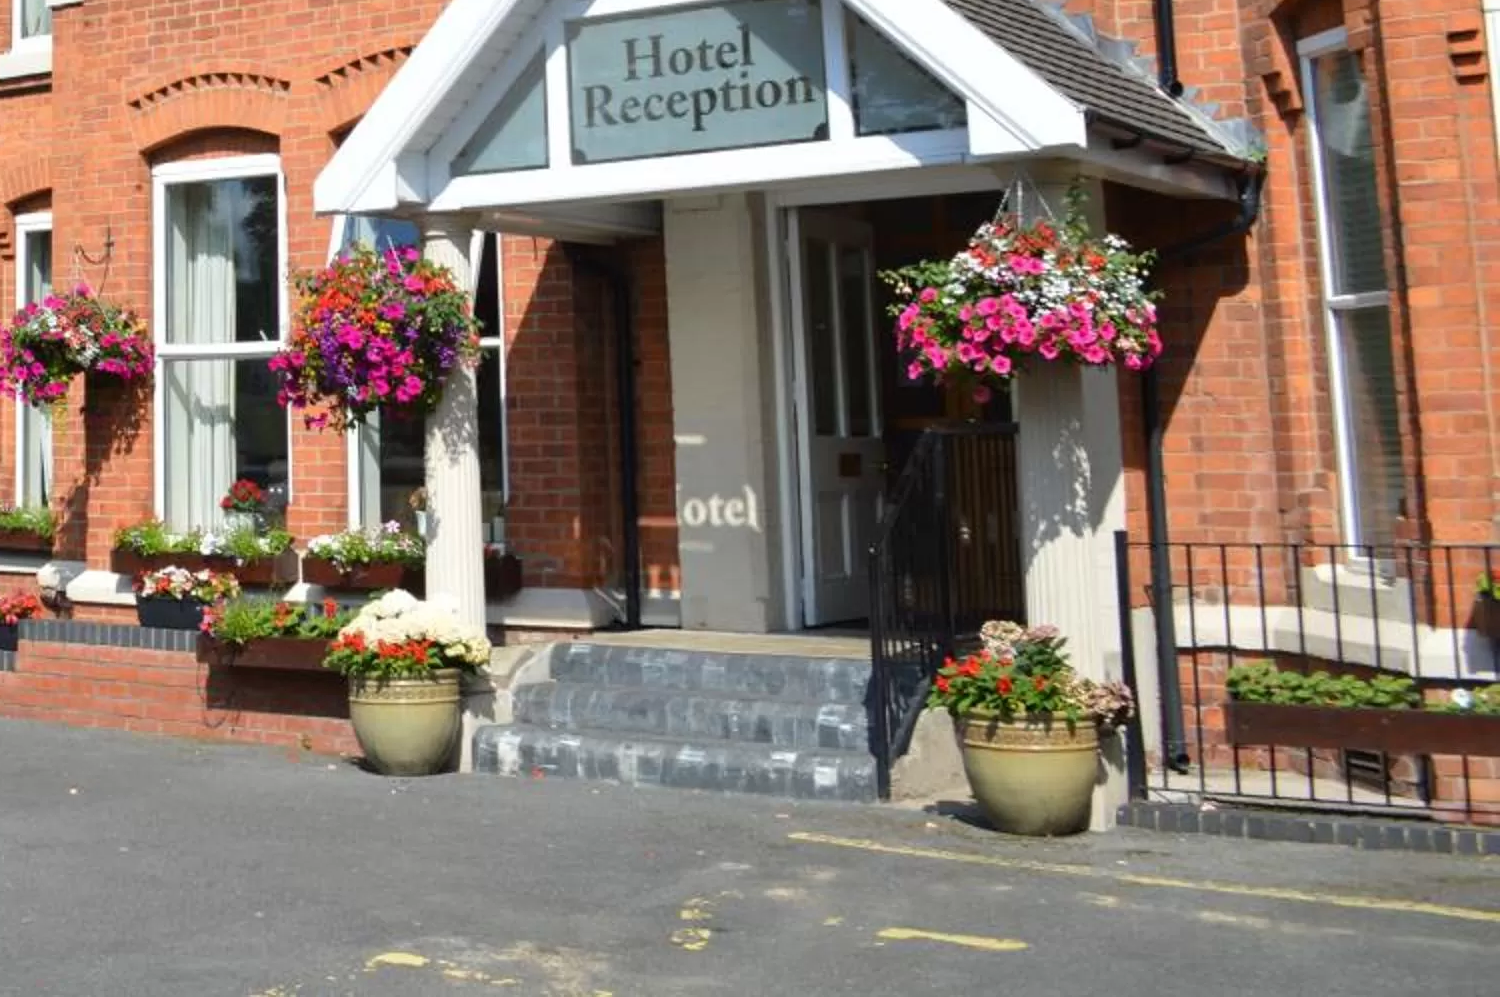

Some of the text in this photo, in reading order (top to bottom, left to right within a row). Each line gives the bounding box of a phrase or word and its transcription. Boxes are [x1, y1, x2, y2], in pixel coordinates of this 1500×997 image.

[623, 23, 755, 80] Hotel
[583, 72, 816, 131] Reception
[676, 483, 761, 533] otel
